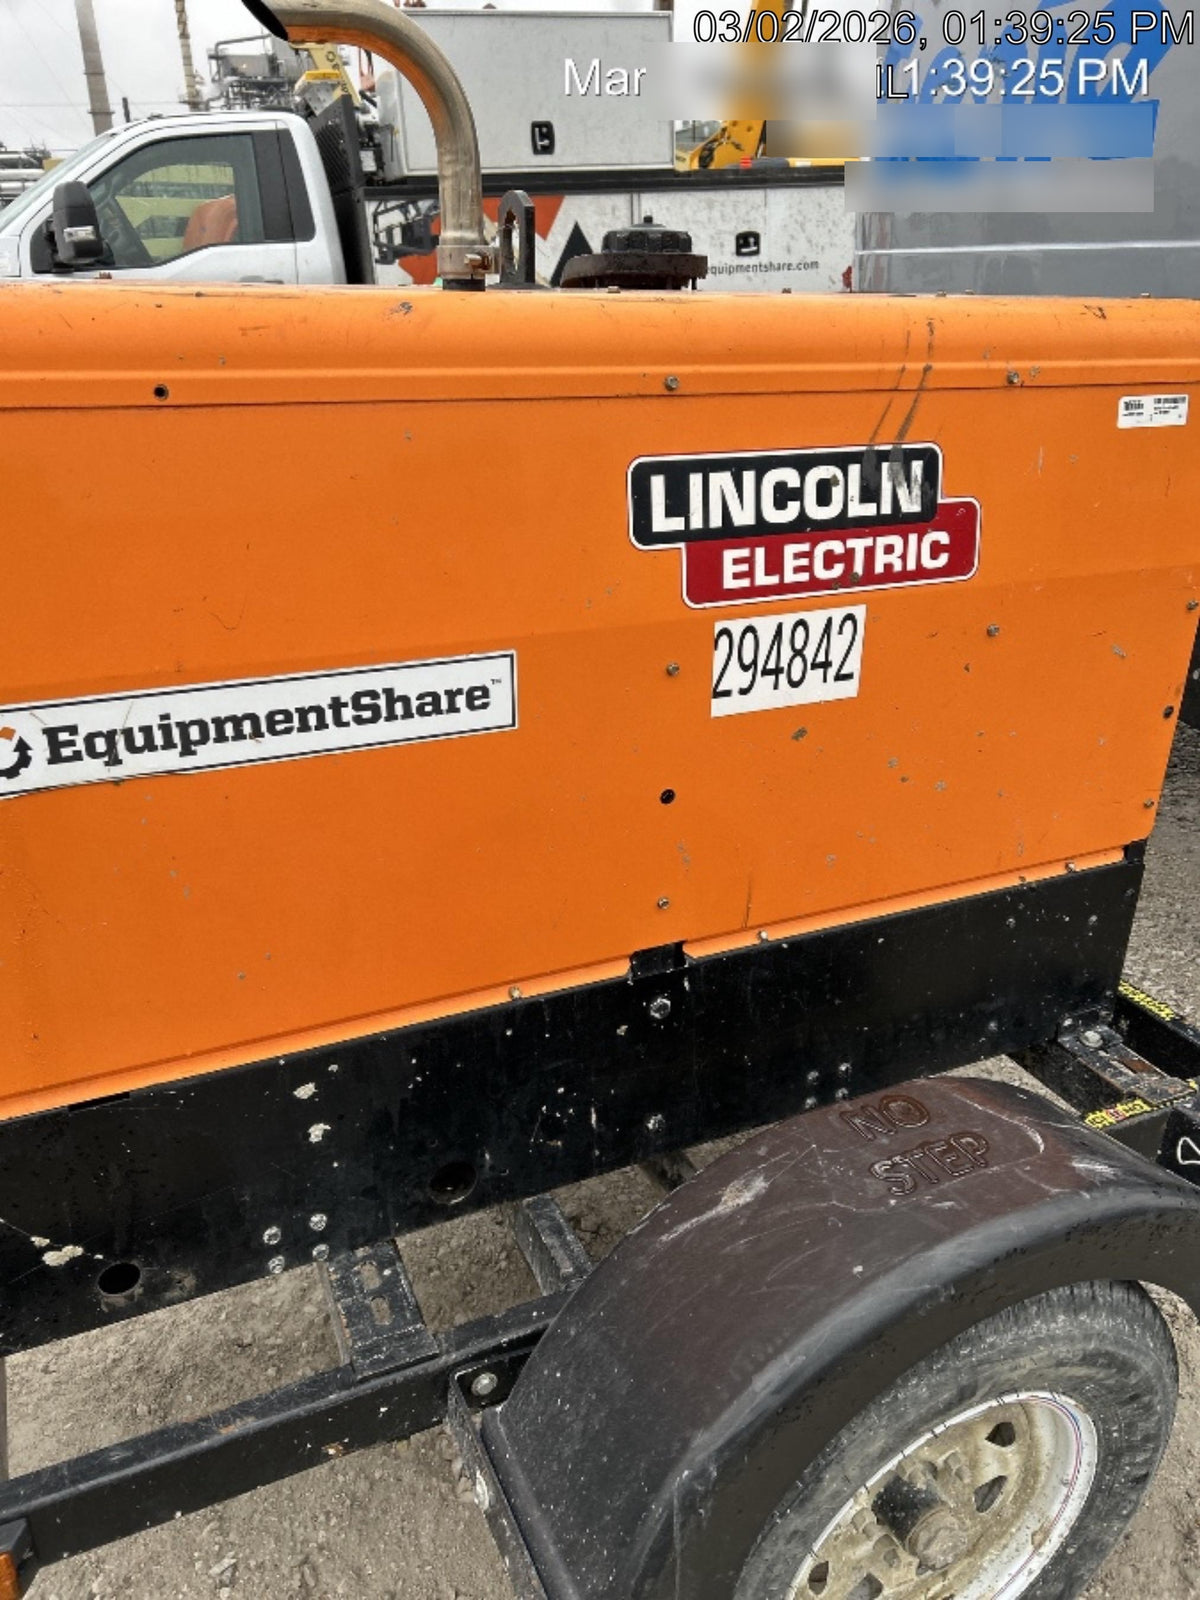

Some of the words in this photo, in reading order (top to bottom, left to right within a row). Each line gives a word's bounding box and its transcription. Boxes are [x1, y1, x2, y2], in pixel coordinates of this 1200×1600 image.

[707, 260, 820, 277] quipmentshare.com
[650, 459, 924, 533] LINCOLN
[722, 530, 951, 590] ELECTRIC
[712, 612, 858, 699] 294842
[42, 683, 491, 767] EquipmentShare
[840, 1094, 931, 1142] NO
[869, 1132, 990, 1196] STEP
